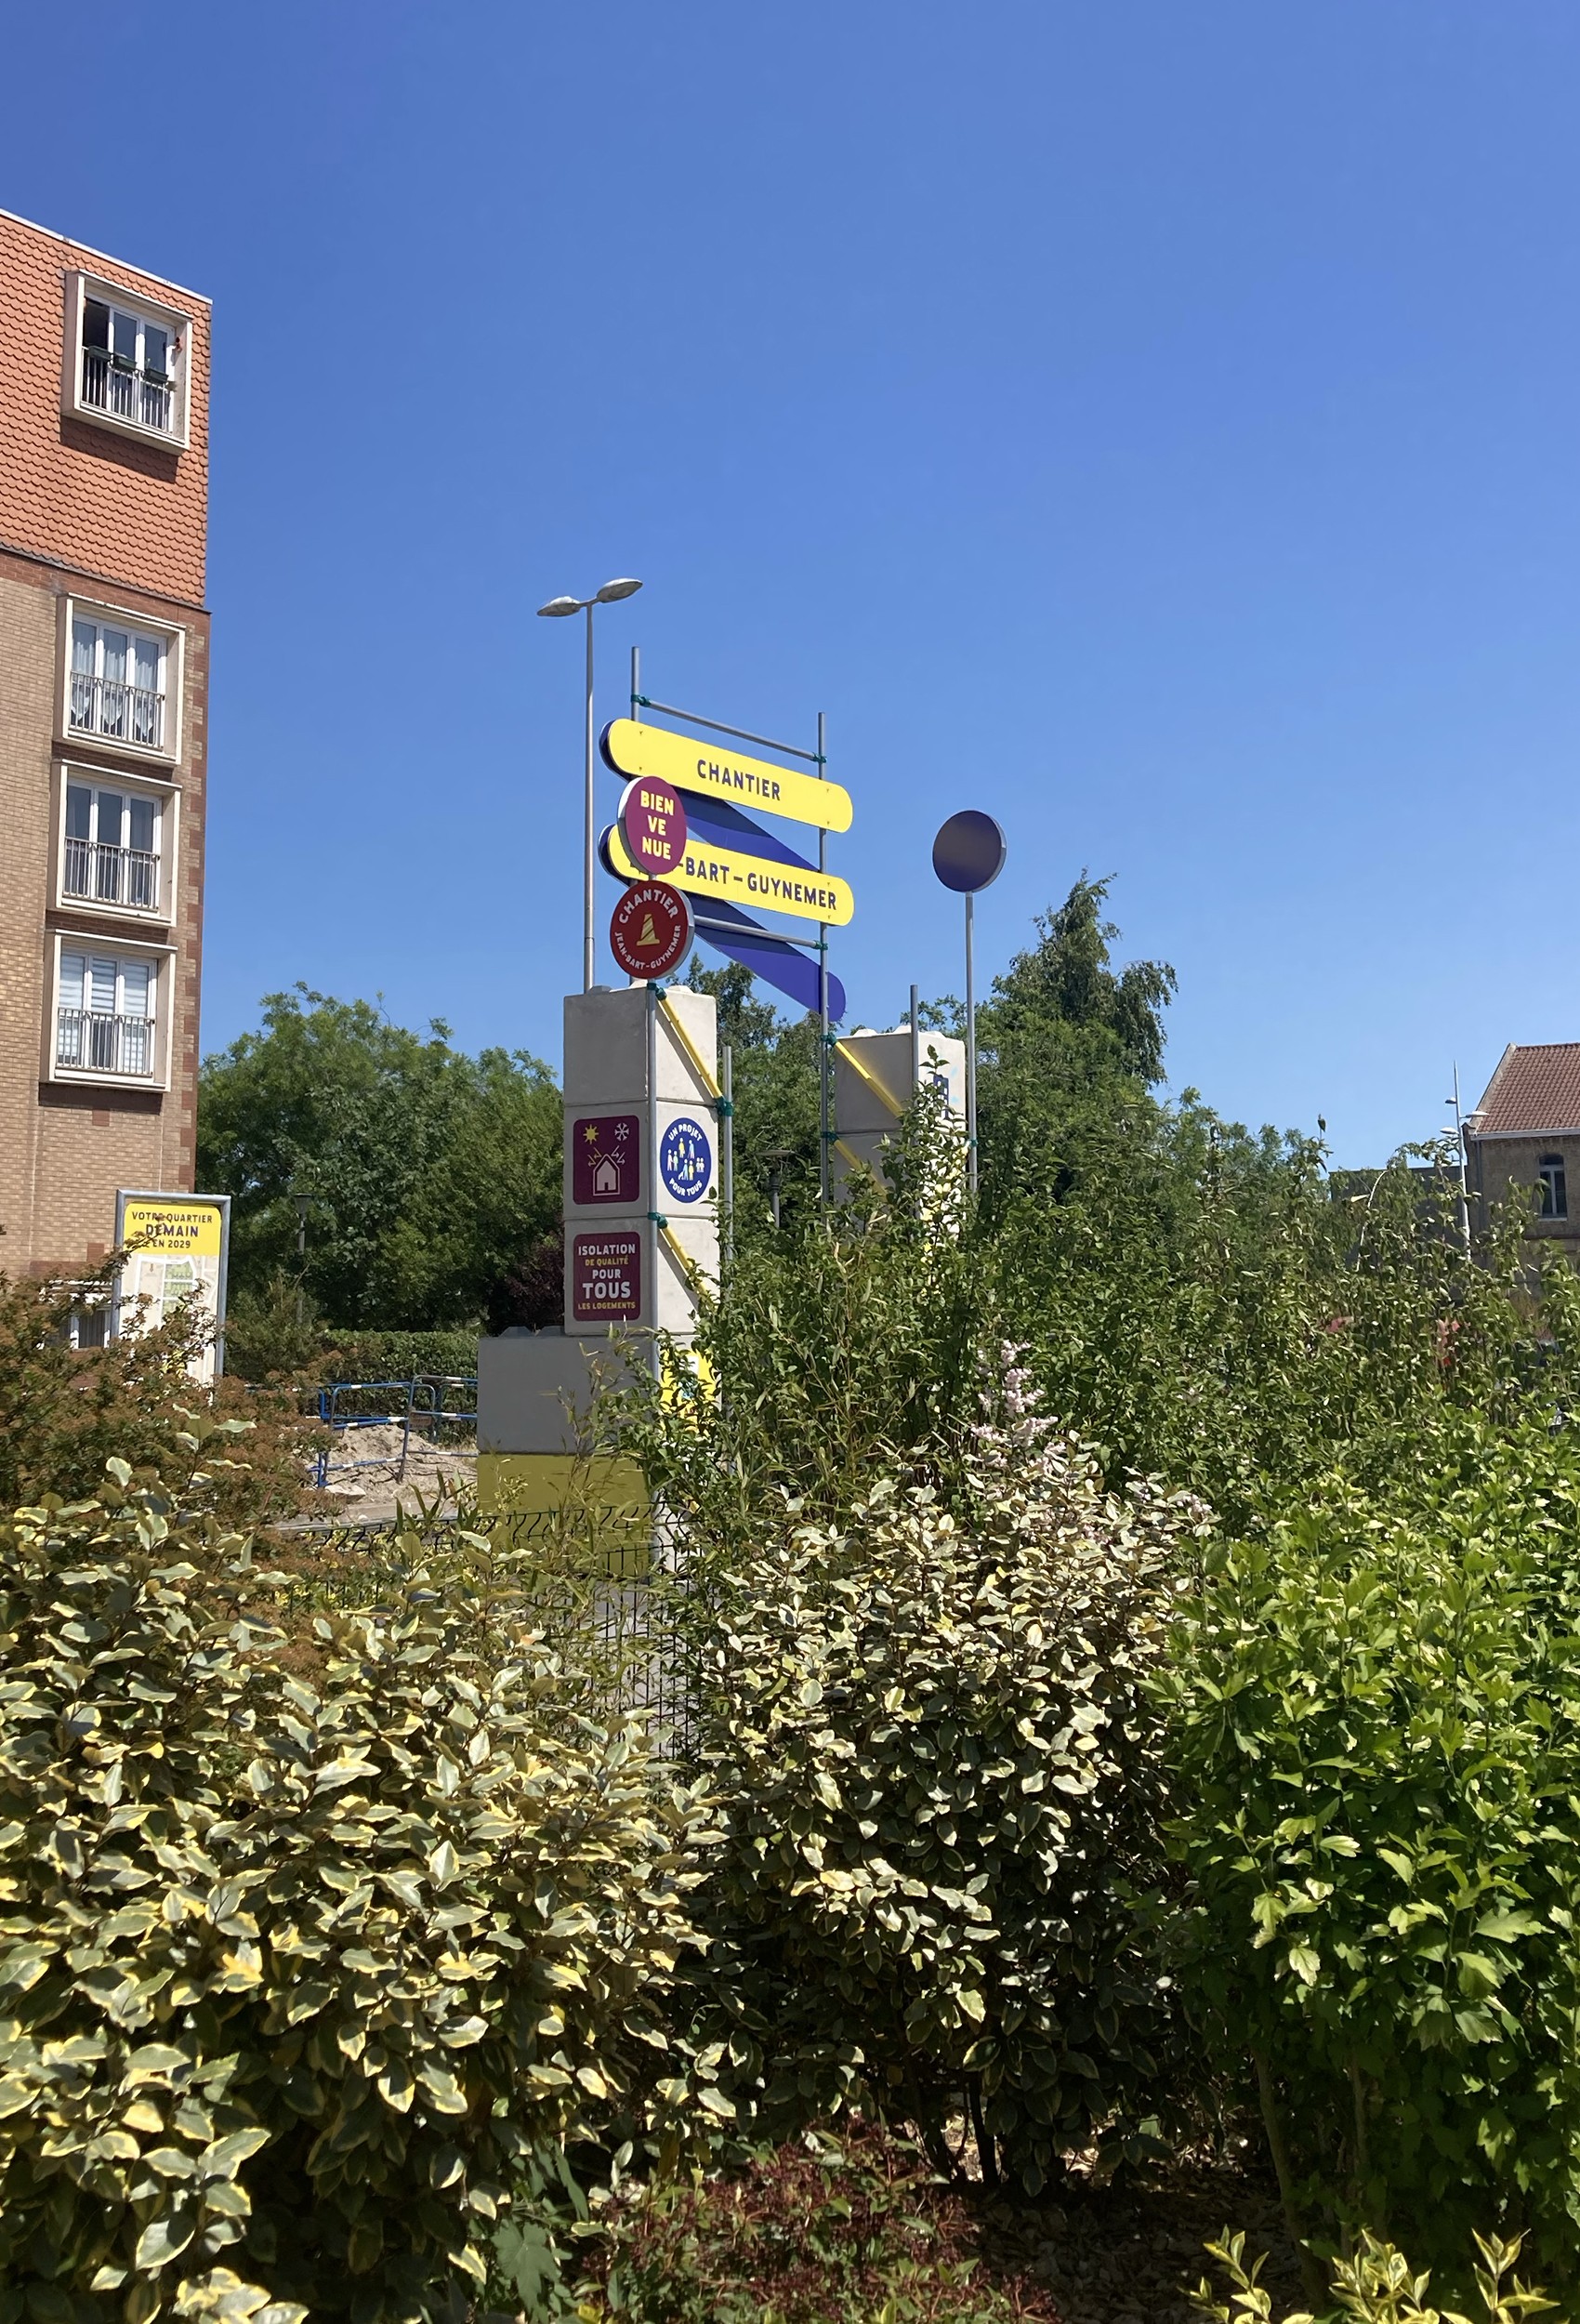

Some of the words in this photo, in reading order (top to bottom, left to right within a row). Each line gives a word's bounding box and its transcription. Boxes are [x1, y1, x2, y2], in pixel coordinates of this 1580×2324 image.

[697, 759, 781, 801] CHANTIER
[640, 790, 674, 816] BIEN
[647, 815, 666, 836] VE
[641, 836, 671, 860] NUE
[619, 889, 679, 918] CHANTIER
[614, 925, 681, 970] JEAN-BART-GUYNEMER
[668, 1127, 678, 1141] UN
[678, 1123, 703, 1142] PROJET
[669, 1178, 686, 1195] POUR
[687, 1180, 703, 1196] TOUS
[132, 1211, 163, 1221] VOTR
[166, 1213, 212, 1223] QUARTIER
[145, 1223, 198, 1237] DEMAIN
[153, 1238, 165, 1248] EN
[168, 1239, 191, 1248] 2029
[578, 1244, 636, 1256] ISOLATION
[597, 1255, 629, 1267] QUALITÉ
[592, 1269, 621, 1279] POUR
[582, 1281, 631, 1300] TOUS
[592, 1301, 636, 1310] LOGEMENTS
